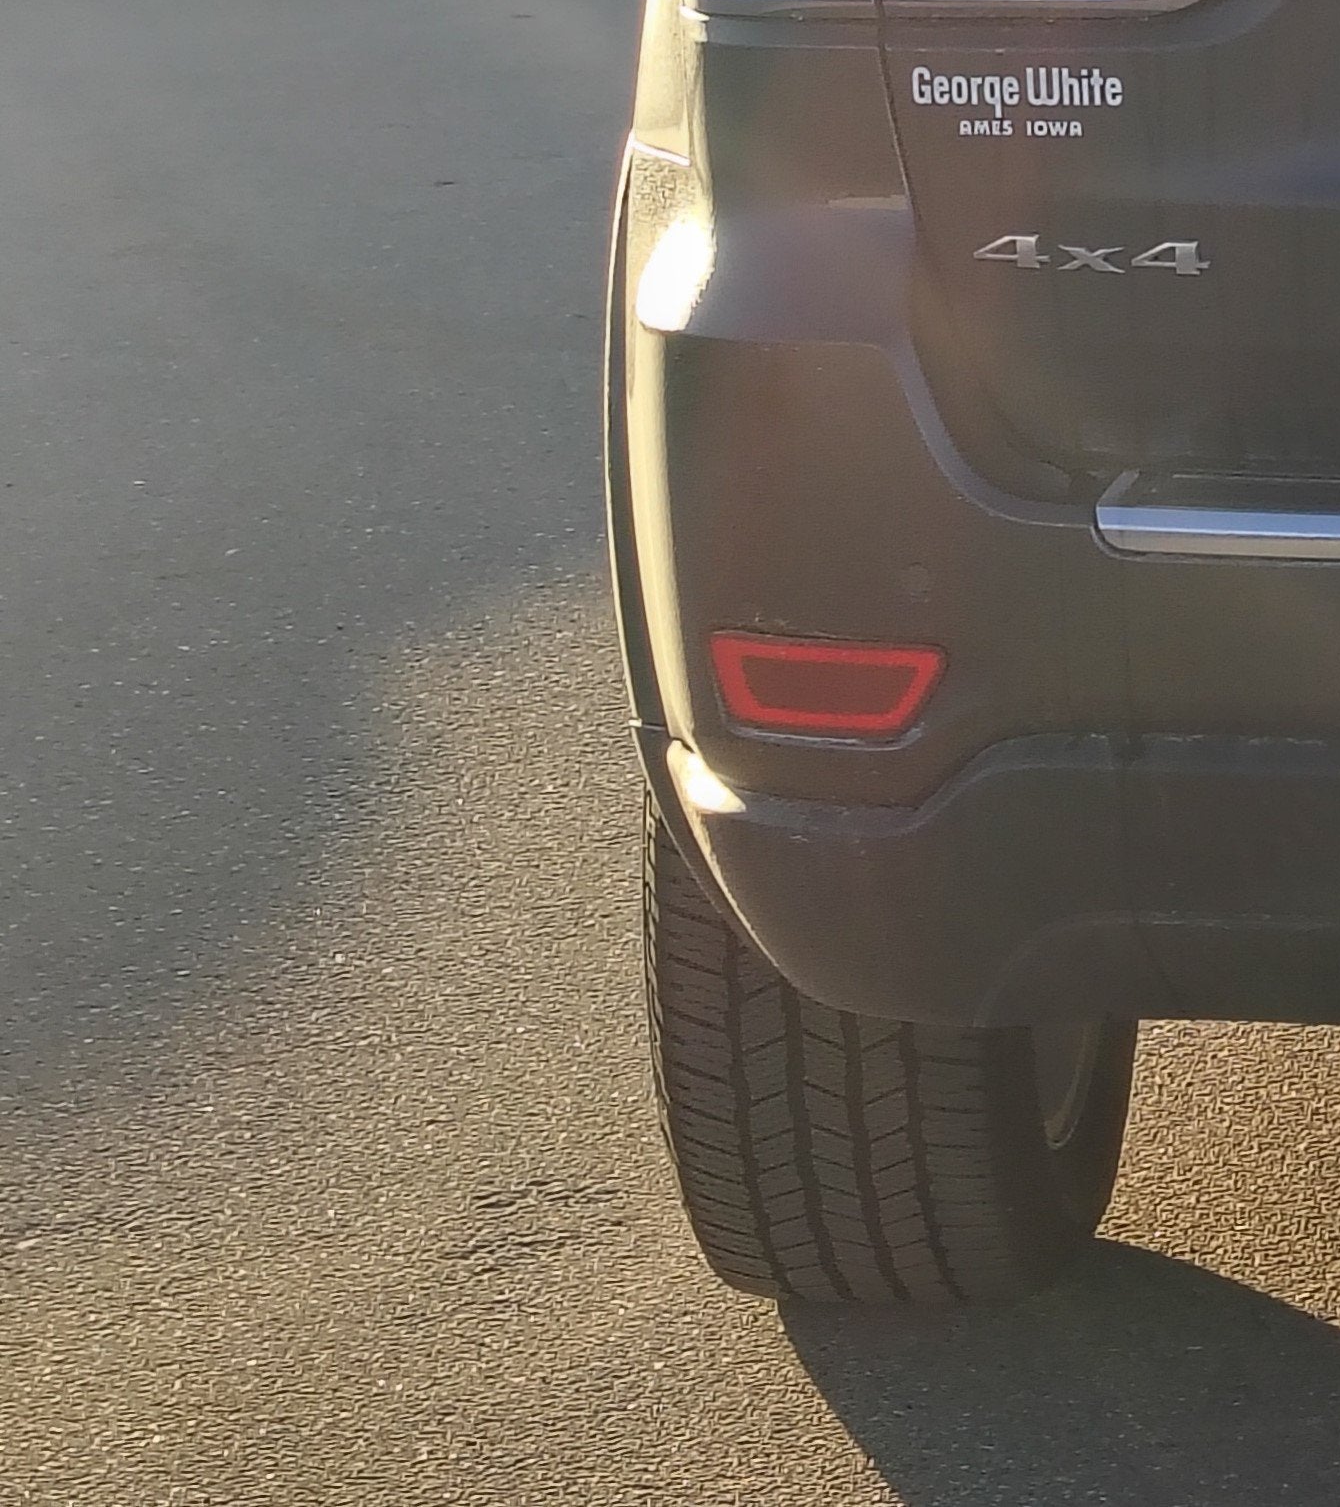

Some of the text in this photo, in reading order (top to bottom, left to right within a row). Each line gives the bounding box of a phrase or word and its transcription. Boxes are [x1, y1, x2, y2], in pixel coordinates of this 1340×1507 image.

[911, 66, 1124, 118] George White
[958, 120, 1083, 137] AMES IOWA
